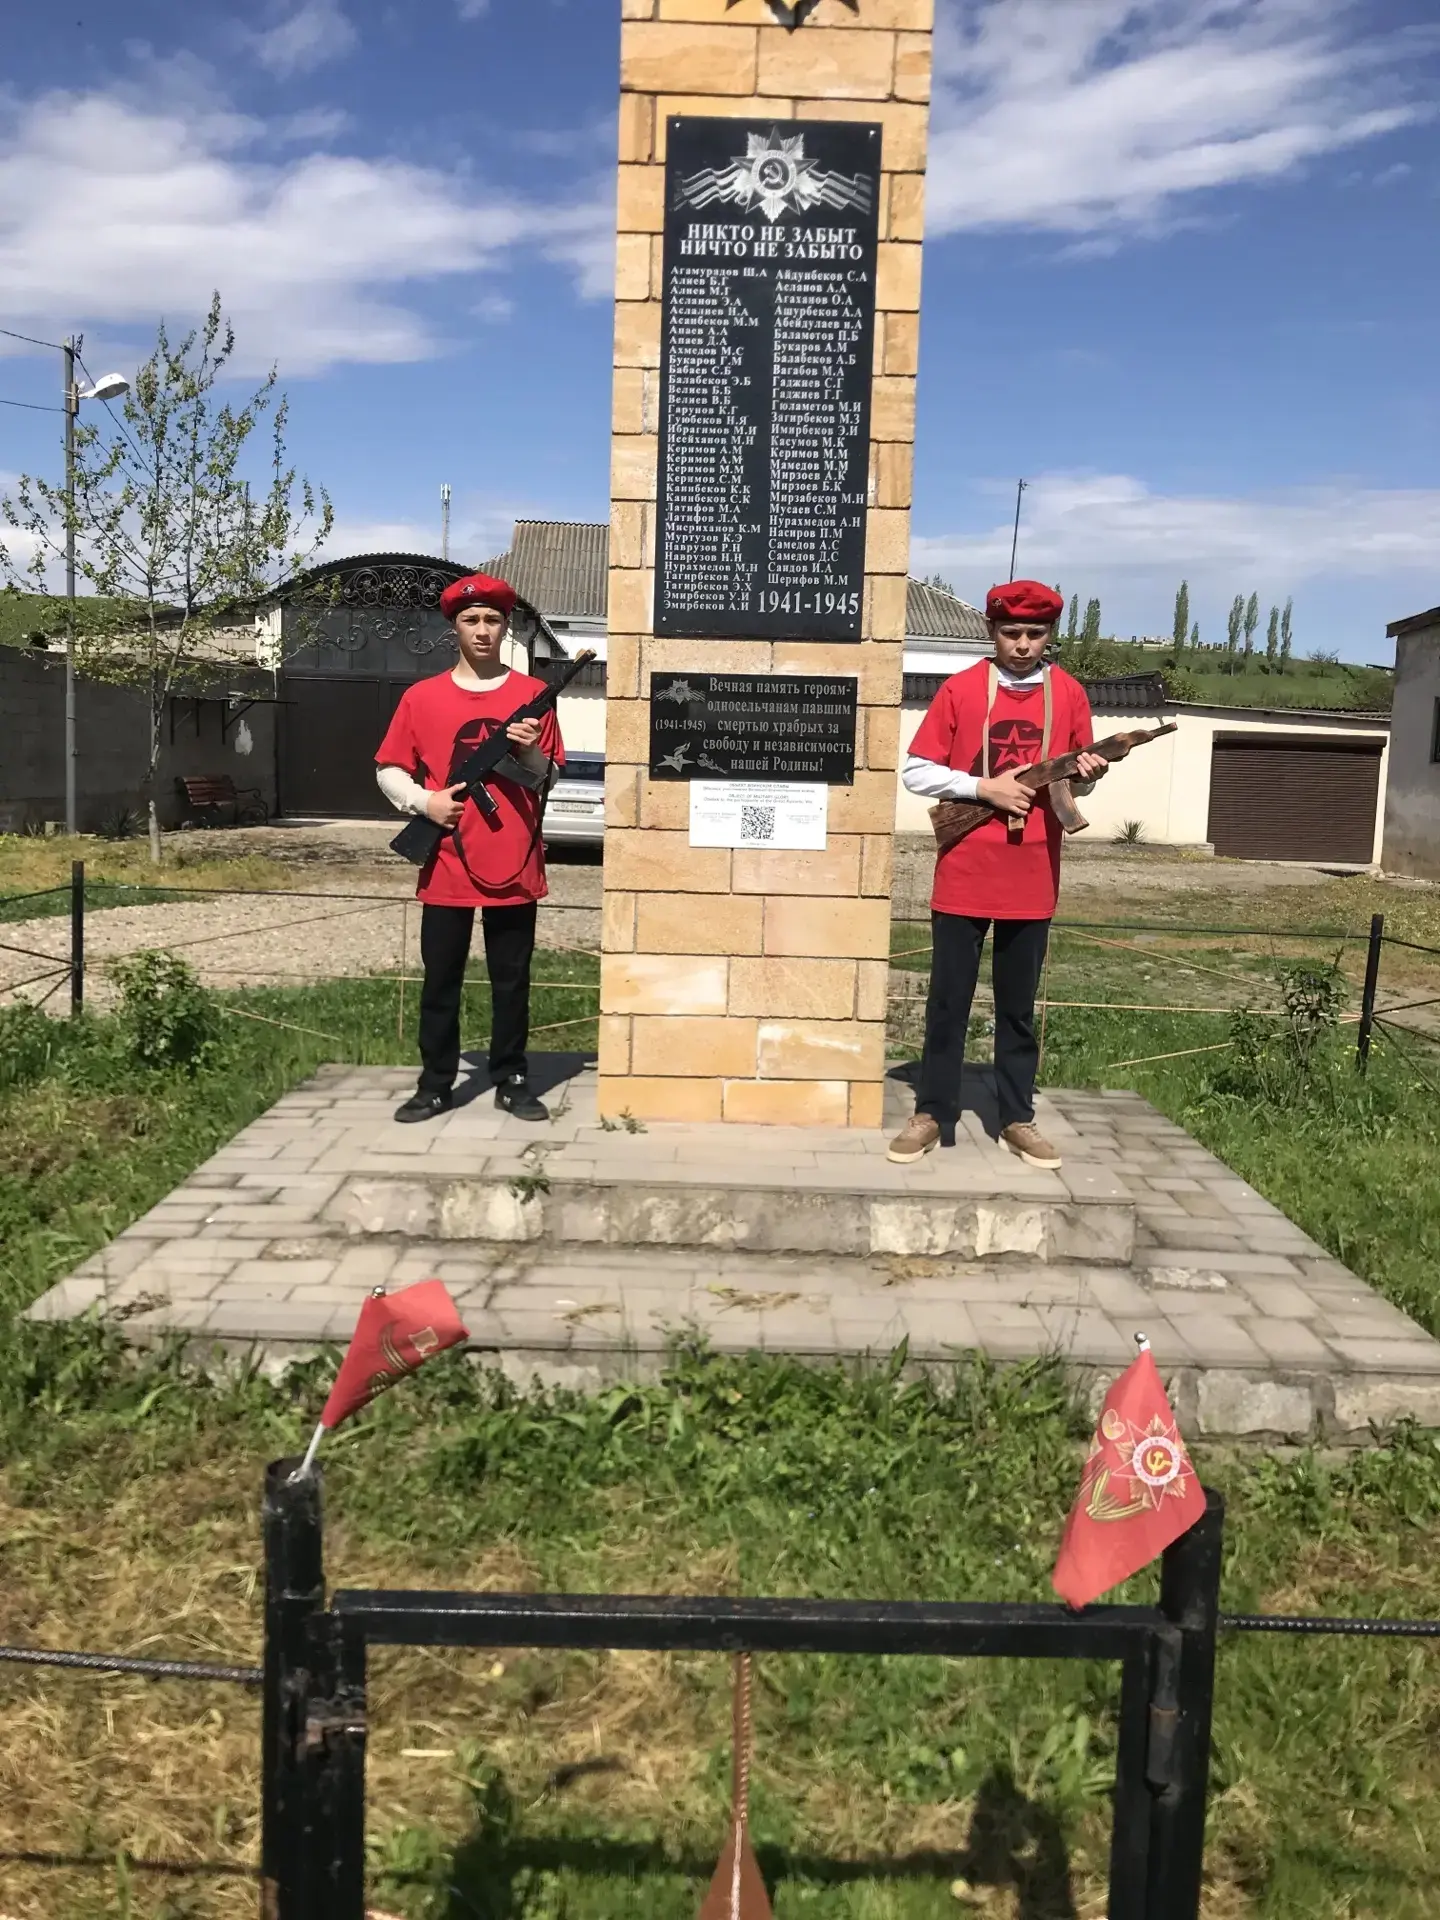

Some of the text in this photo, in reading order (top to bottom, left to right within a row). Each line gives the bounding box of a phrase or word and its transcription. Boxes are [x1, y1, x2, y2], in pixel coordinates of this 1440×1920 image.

[688, 223, 857, 244] НИКТО НЕ ЗАБЫТ
[680, 240, 864, 260] НИЧТО НЕ ЗАБЫТО
[671, 266, 739, 277] Агамурадов
[670, 276, 705, 285] Алиев
[670, 286, 705, 295] Алиев
[775, 281, 822, 292] Асланов
[670, 296, 717, 305] Асланов
[775, 293, 828, 305] Агаханов
[774, 305, 838, 318] Ашурбеков
[670, 316, 730, 326] Асанбеков
[669, 346, 717, 355] Ахмедов
[773, 341, 820, 353] Букаров
[669, 355, 716, 366] Букаров
[773, 352, 832, 364] Балабеков
[668, 365, 707, 374] Бабаев
[773, 364, 818, 376] Вагабов
[668, 375, 728, 385] Балабеков
[772, 376, 820, 388] Гаджиев
[668, 385, 708, 394] Велиев
[772, 388, 820, 399] Гаджиев
[668, 395, 708, 404] Велиев
[668, 405, 714, 416] Гарунов
[772, 400, 834, 411] Гюламетов
[771, 412, 835, 425] Загирбеков
[668, 424, 730, 435] Ибрагимов
[771, 424, 834, 437] Имирбеков
[771, 435, 818, 448] Касумов
[667, 444, 716, 455] Керимов
[770, 447, 819, 460] Керимов
[667, 454, 716, 465] Керимов
[770, 459, 820, 470] Мамедов
[666, 464, 715, 474] Керимов
[666, 473, 715, 484] Керимов
[770, 470, 820, 482] Мирзоев
[770, 480, 818, 492] Мирзоев
[770, 492, 837, 504] Мирзабеков
[665, 503, 714, 513] Латифов
[769, 504, 810, 516] Мусаев
[665, 512, 714, 524] Латифов
[769, 516, 836, 528] Нурахмедов
[665, 522, 734, 534] Мисриханов
[665, 532, 718, 543] Муртузов
[769, 528, 816, 540] Насиров
[665, 542, 717, 553] Наврузов
[768, 539, 815, 550] Самедов
[664, 552, 717, 563] Наврузов
[768, 550, 814, 562] Самедов
[664, 562, 731, 572] Нурахмедов
[664, 571, 729, 582] Тагирбеков
[768, 574, 820, 587] Шерифов
[664, 581, 728, 591] Тагирбеков
[664, 590, 724, 602] Эмирбеков
[664, 600, 724, 611] Эмирбеков
[758, 590, 859, 614] 1941-1945
[709, 677, 851, 698] Вечная память героям-
[708, 699, 851, 714] односельчанам павшим
[655, 719, 706, 732] (1941-1945)
[718, 719, 839, 736] смертью храбрых за
[703, 736, 852, 753] свободу и независимость
[731, 756, 823, 772] нашей Родины!
